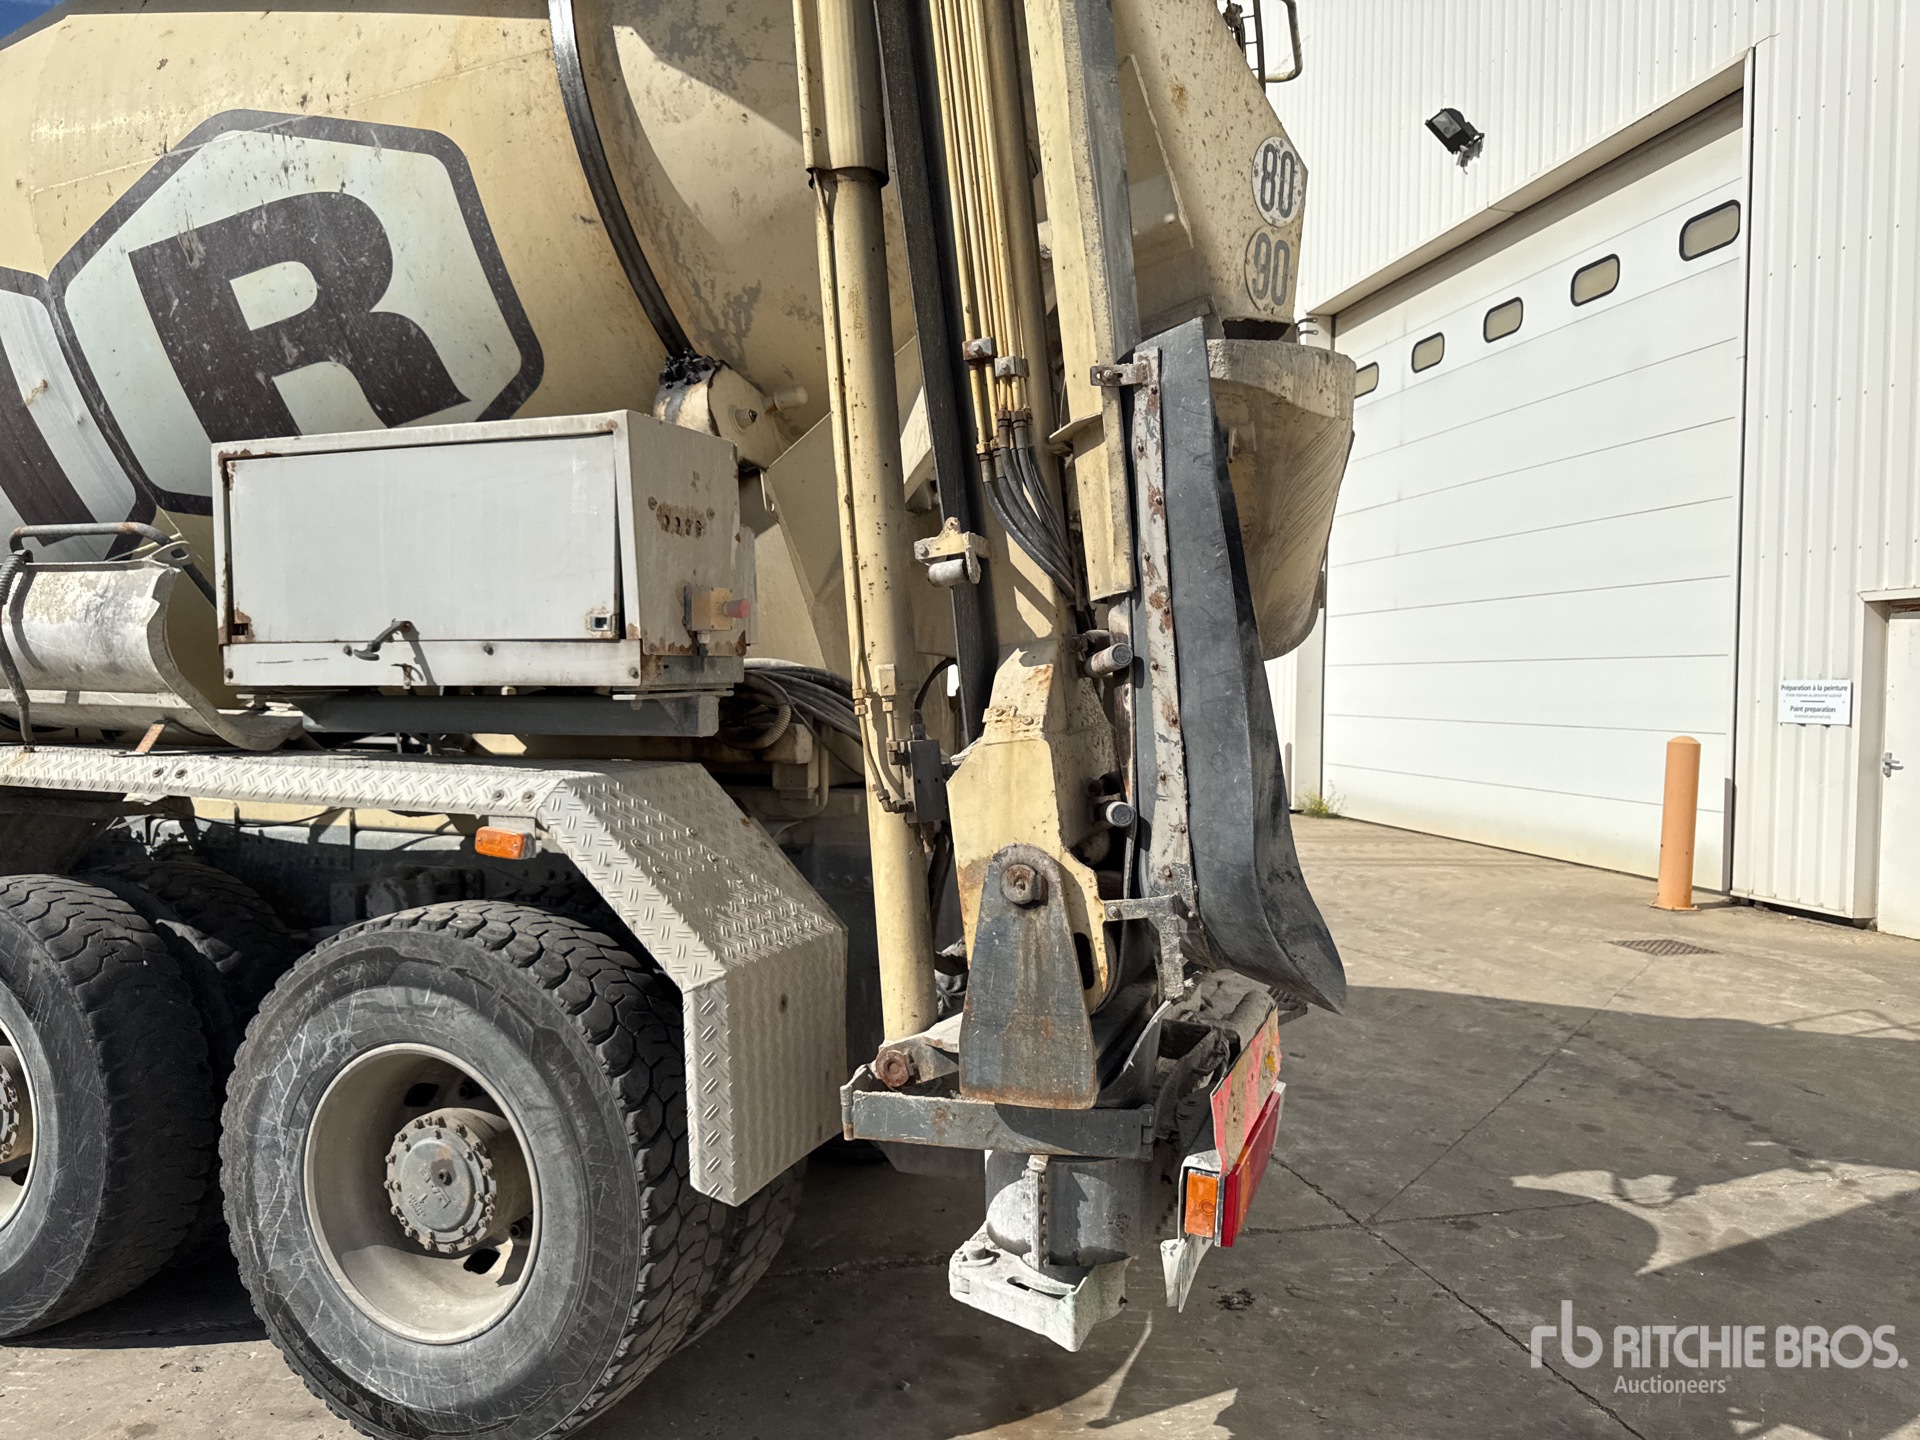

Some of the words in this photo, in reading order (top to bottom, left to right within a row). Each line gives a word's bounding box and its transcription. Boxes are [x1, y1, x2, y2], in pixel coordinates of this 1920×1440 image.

[1259, 142, 1295, 219] 80
[1251, 232, 1290, 306] 90
[128, 191, 472, 443] R
[1781, 684, 1811, 692] Préparation
[1823, 684, 1848, 692] peinture
[1804, 705, 1836, 713] preparation
